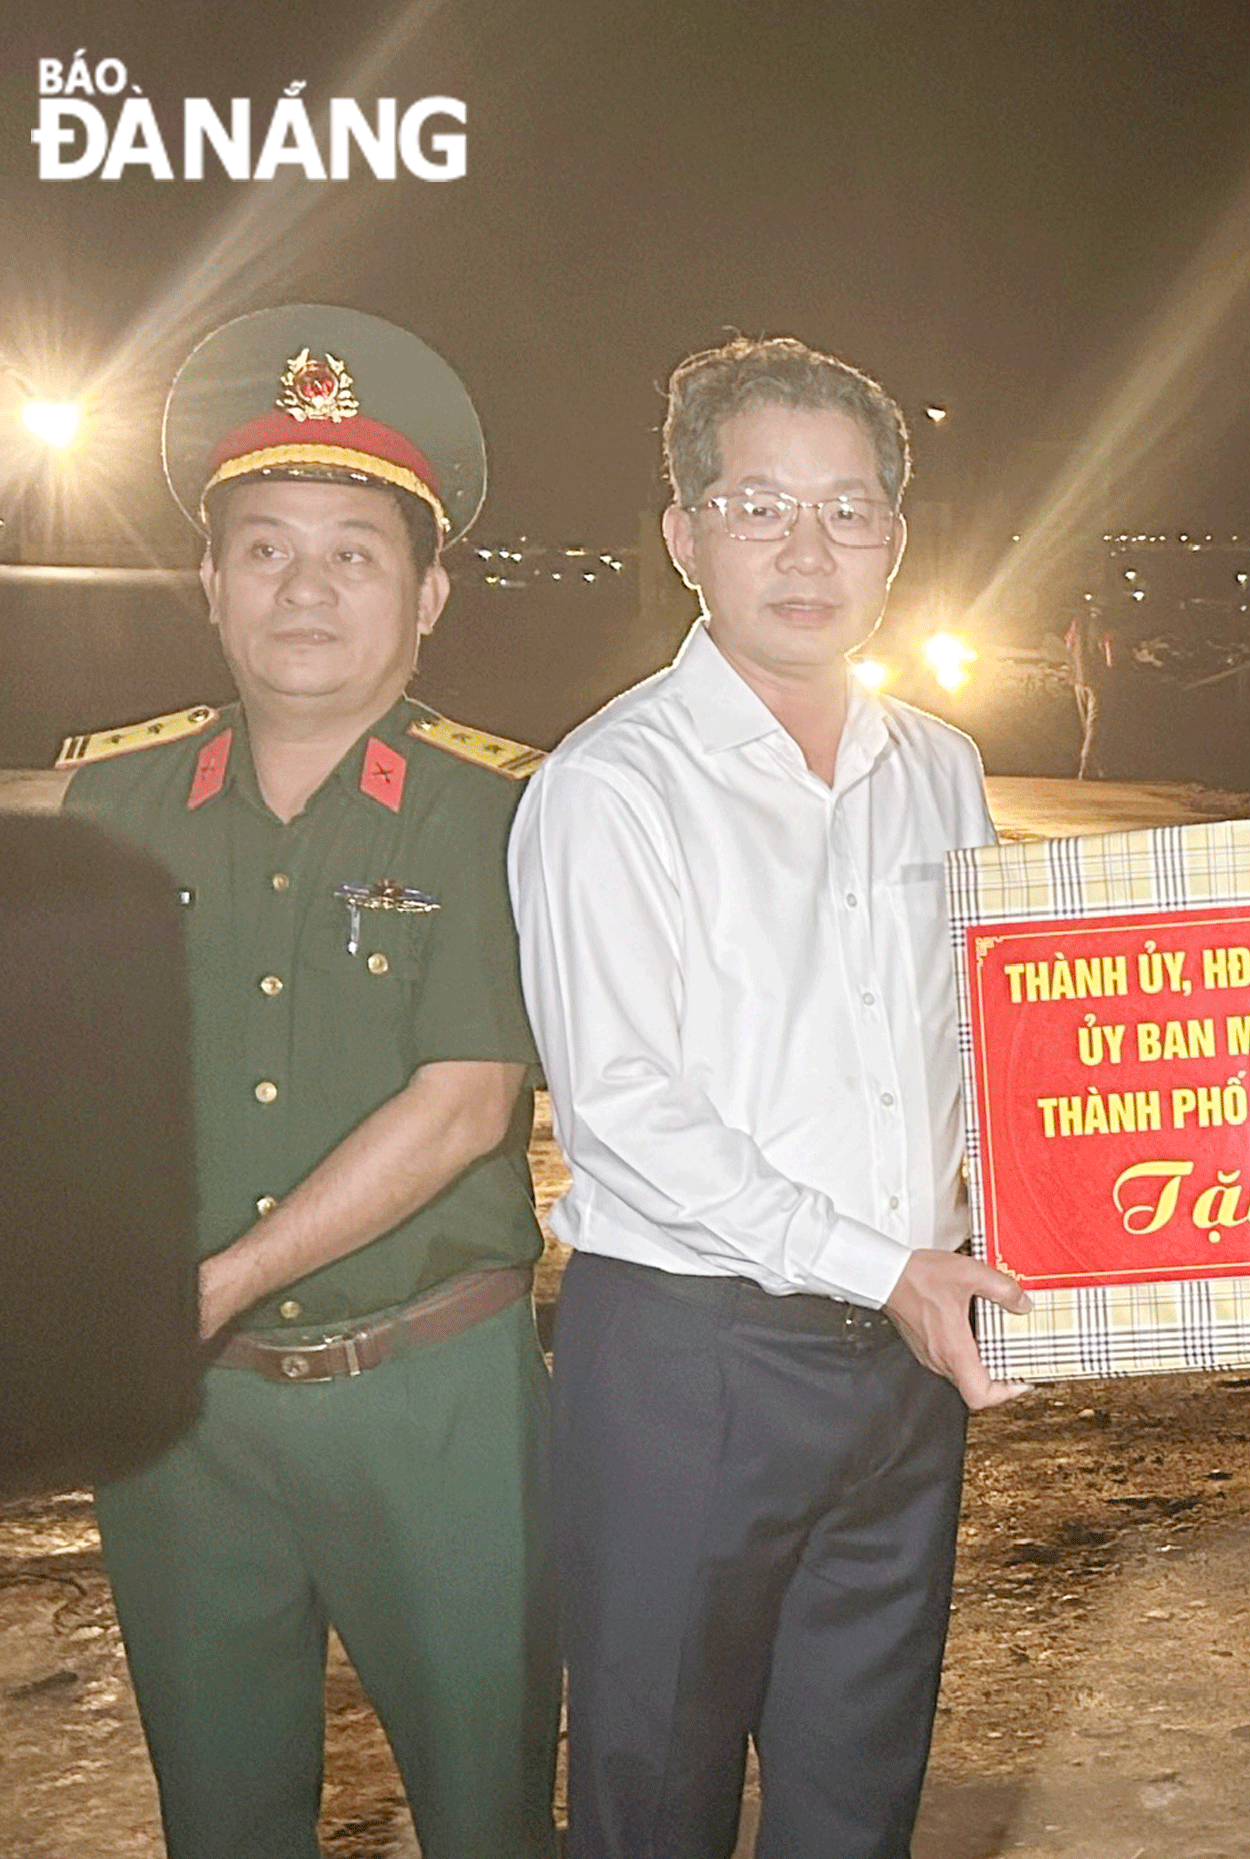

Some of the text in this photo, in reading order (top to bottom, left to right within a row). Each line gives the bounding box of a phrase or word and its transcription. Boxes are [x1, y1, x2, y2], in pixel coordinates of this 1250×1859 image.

[1005, 951, 1127, 1003] THÀNH
[1138, 940, 1192, 997] ỦY,
[1078, 1013, 1124, 1066] ỦY
[1137, 1019, 1215, 1062] BAN
[1037, 1086, 1162, 1138] THÀNH
[1173, 1070, 1247, 1129] PHỐ
